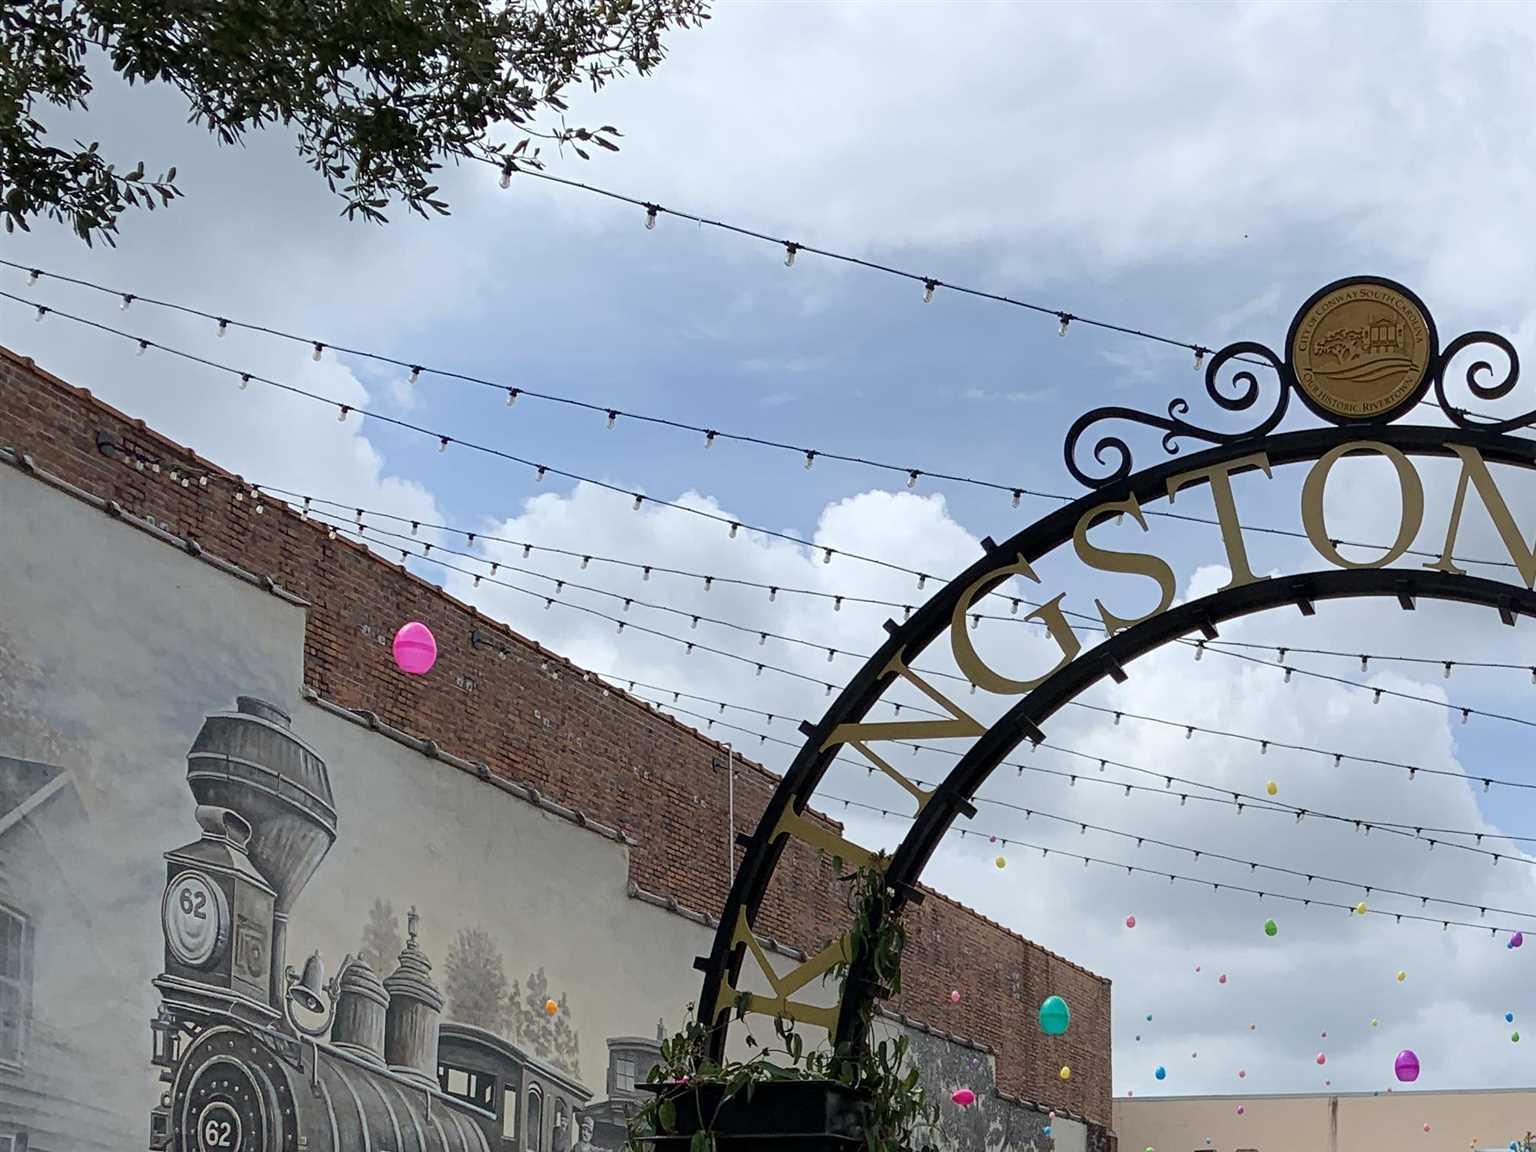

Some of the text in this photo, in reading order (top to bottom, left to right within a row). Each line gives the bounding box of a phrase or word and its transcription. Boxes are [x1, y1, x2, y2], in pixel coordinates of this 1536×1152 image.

[1298, 327, 1311, 352] CITY
[1314, 290, 1359, 317] CONWAY
[1359, 288, 1396, 303] SOUTH
[1395, 299, 1425, 344] CAROLINA
[1303, 373, 1414, 413] OUR HISTORIC RIVERTOWN
[179, 887, 207, 920] 62
[205, 1120, 231, 1147] 62
